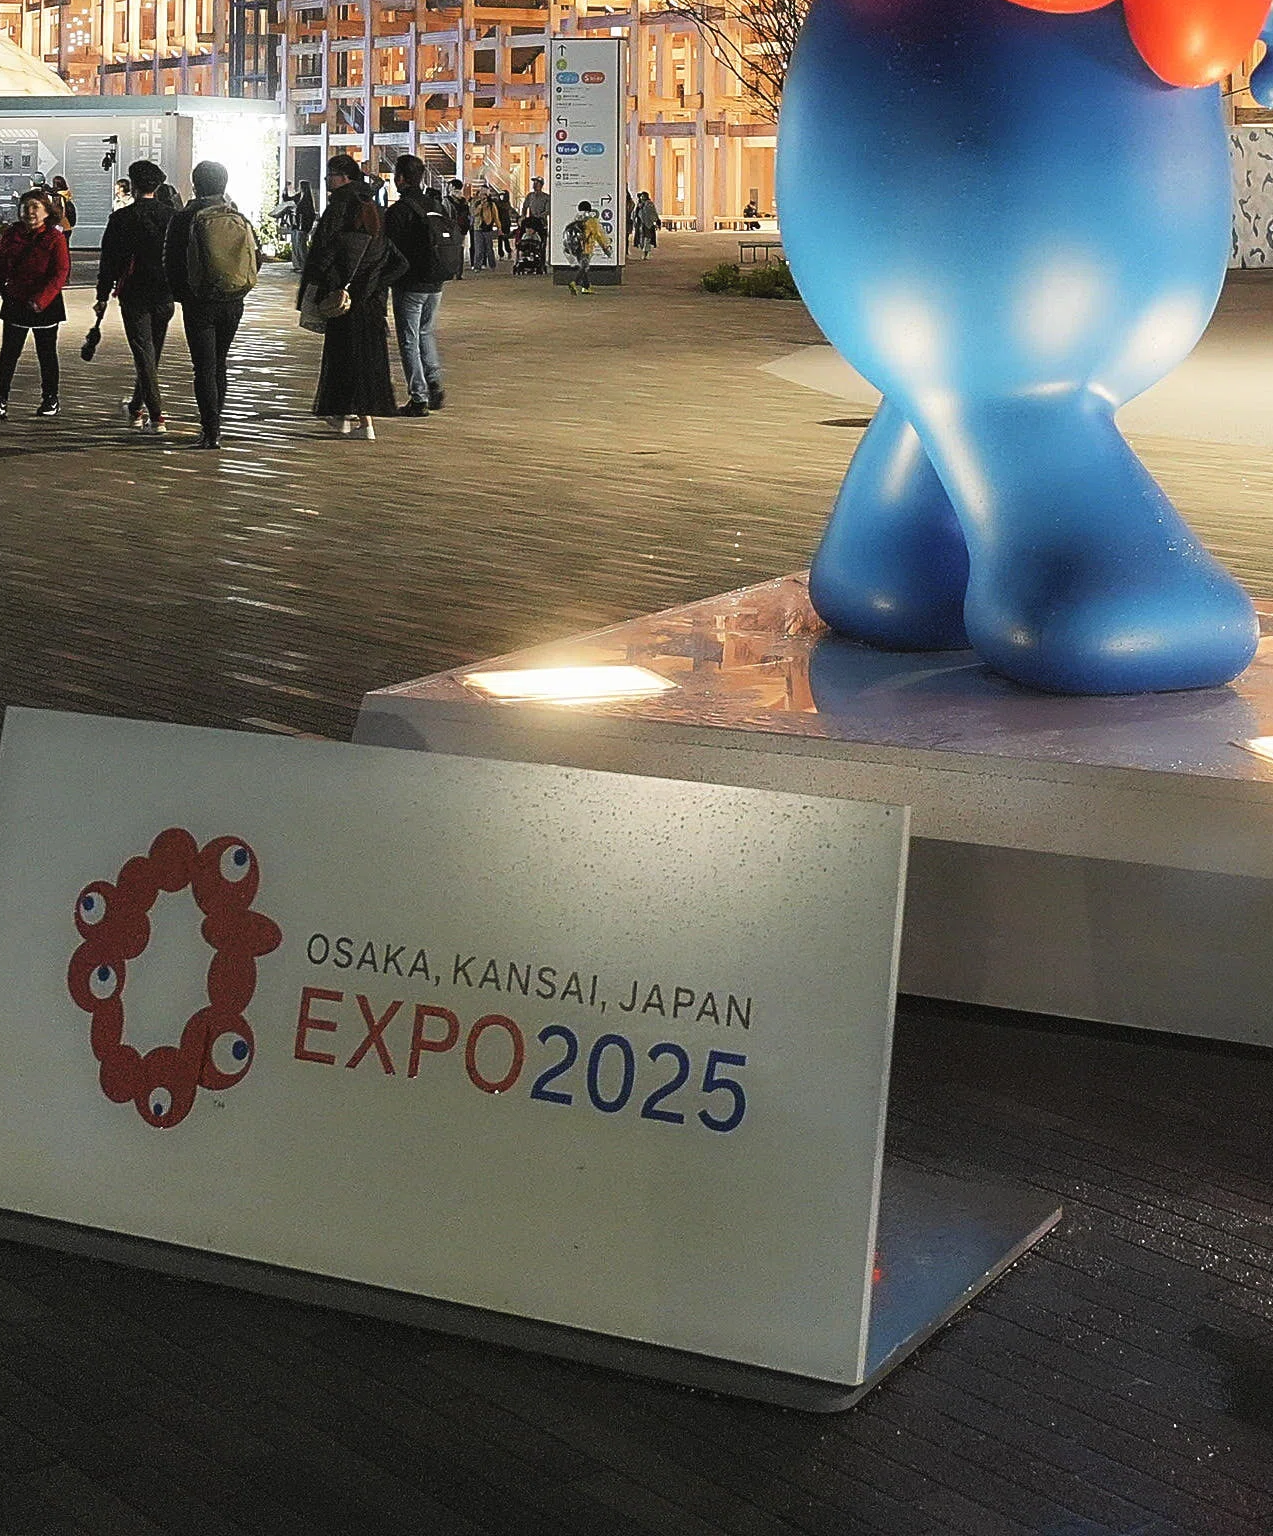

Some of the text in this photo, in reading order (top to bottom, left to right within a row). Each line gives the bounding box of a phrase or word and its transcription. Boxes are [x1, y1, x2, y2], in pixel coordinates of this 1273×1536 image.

[306, 932, 753, 1031] OSAKA, KANSAI, JAPAN
[293, 985, 748, 1133] EXPO2025
